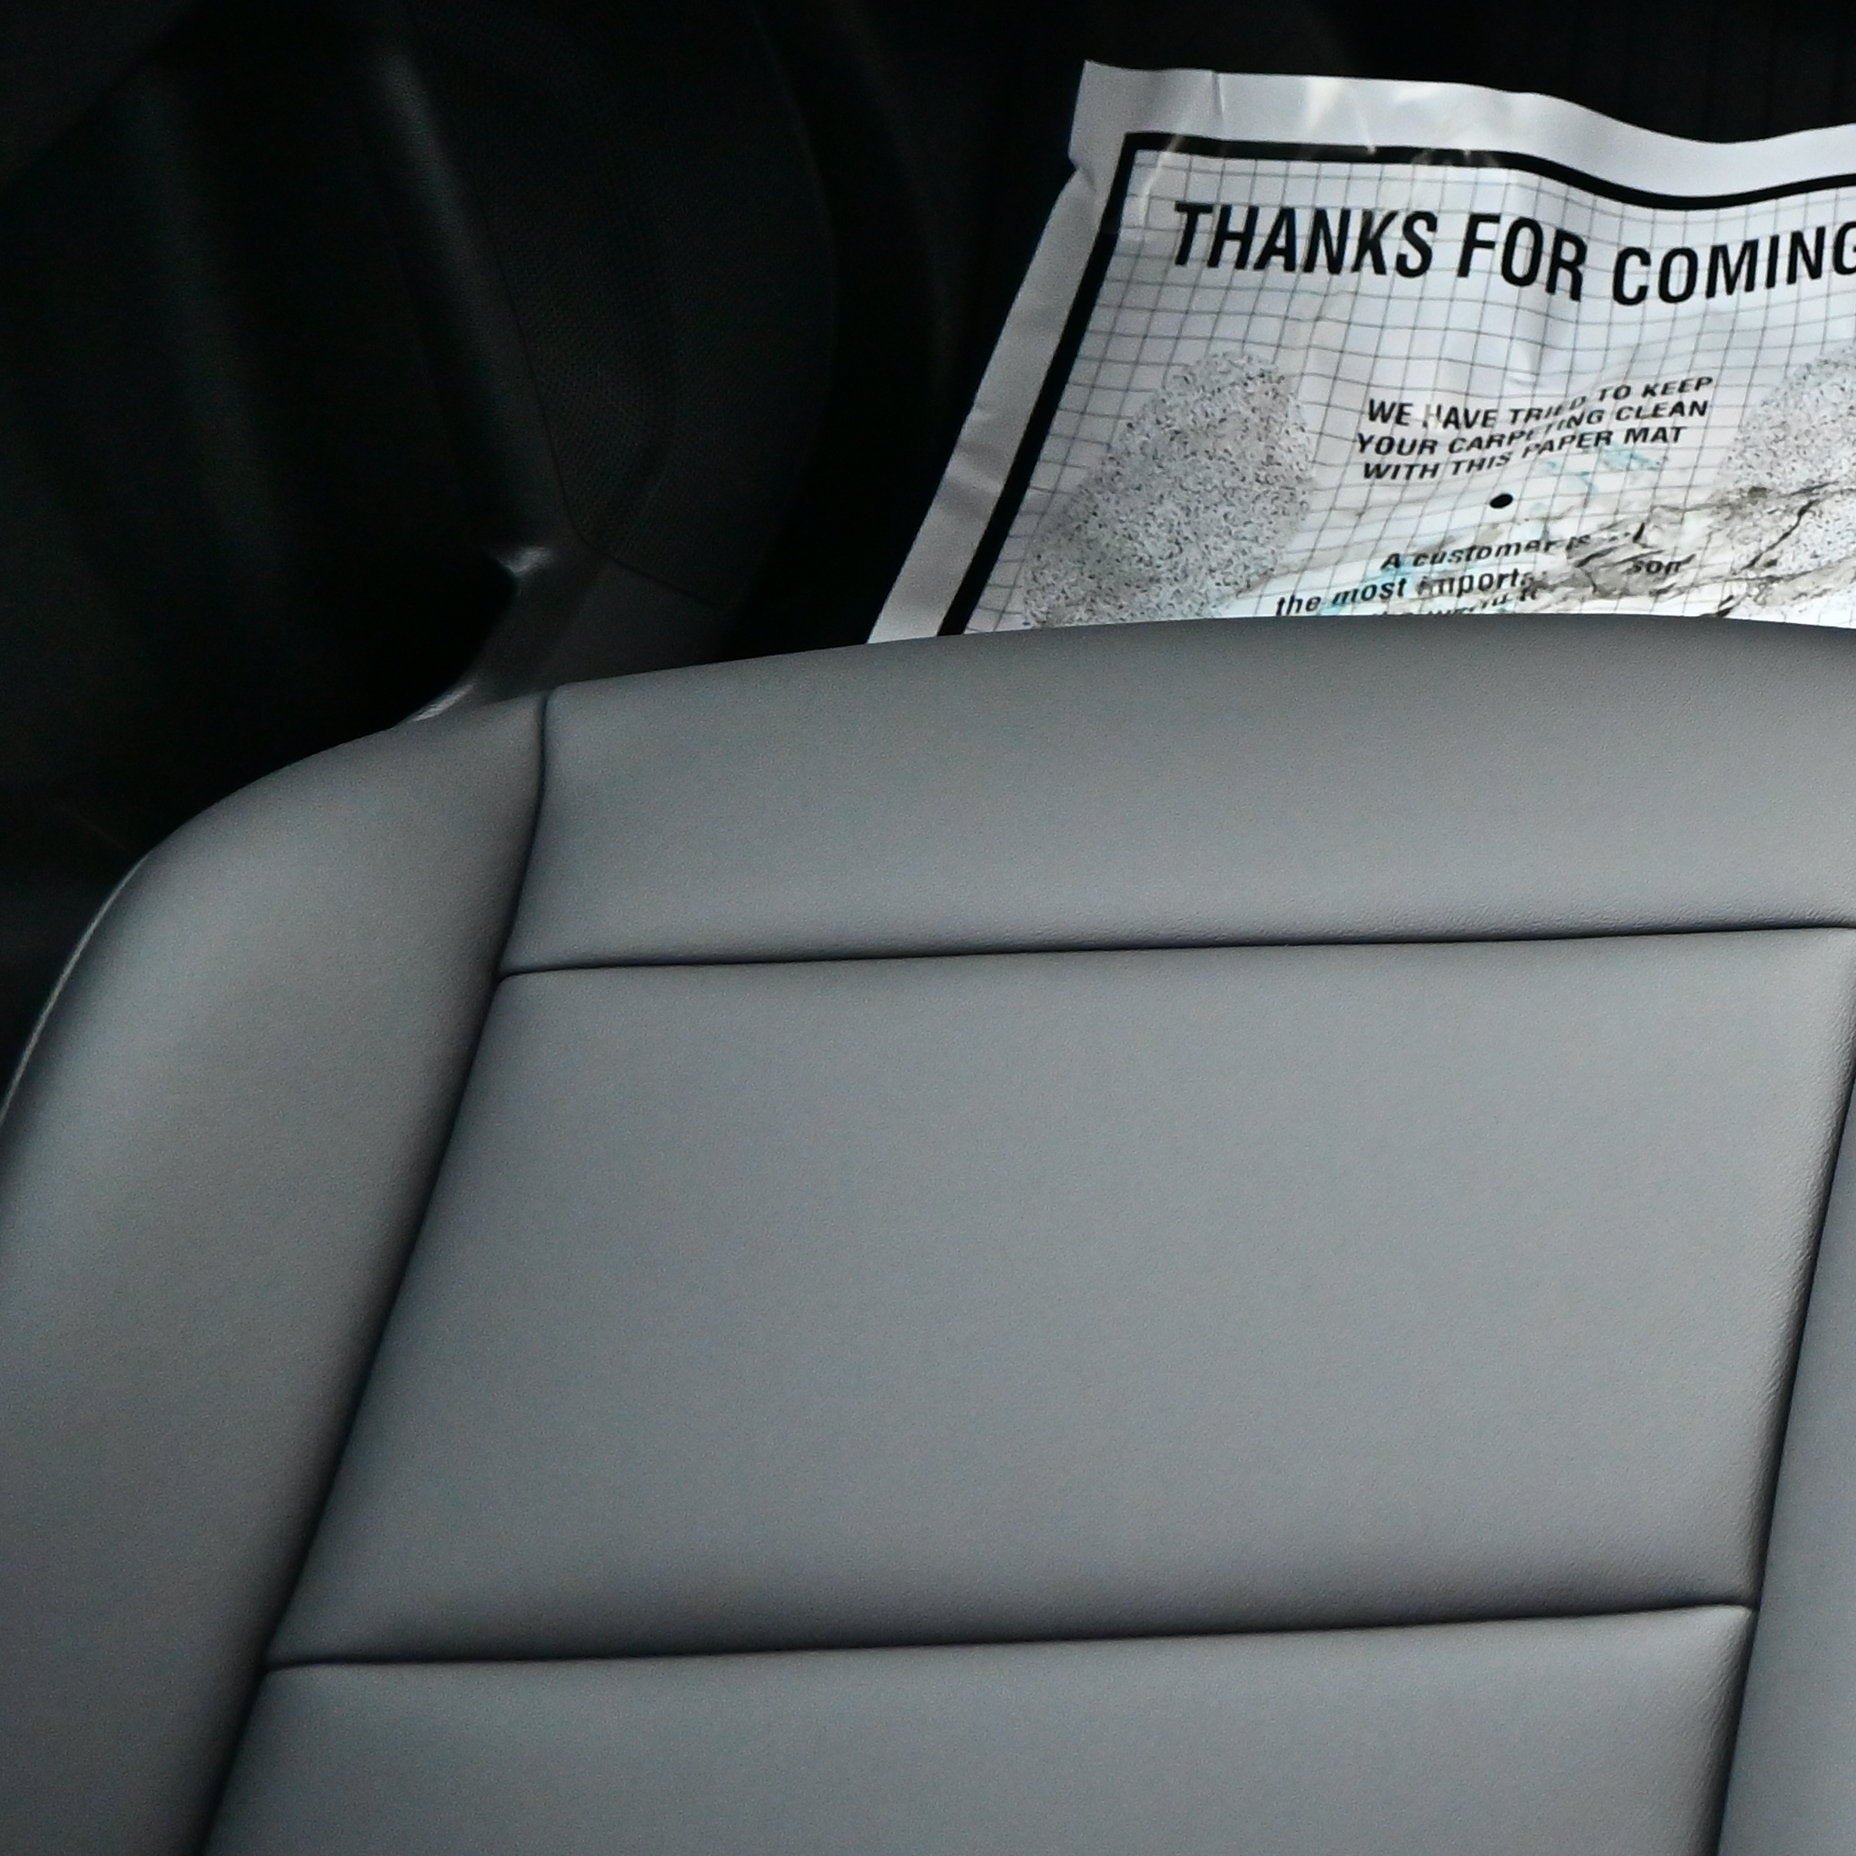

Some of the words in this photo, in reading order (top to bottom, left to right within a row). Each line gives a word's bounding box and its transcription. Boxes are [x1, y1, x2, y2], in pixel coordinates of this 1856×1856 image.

[1173, 202, 1437, 279] THANKS
[1457, 213, 1587, 305] FOR
[1357, 433, 1437, 456] YOUR
[1615, 400, 1709, 422] CLEAN
[1368, 399, 1413, 427] WE
[1422, 404, 1497, 430] HAVE
[1600, 384, 1631, 402] TO
[1641, 377, 1714, 399] KEEP
[1363, 462, 1440, 481] WITH
[1451, 452, 1512, 476] THIS
[1521, 430, 1613, 458] PAPER
[1624, 425, 1687, 445] MAT
[1380, 552, 1401, 570] A
[1413, 539, 1556, 567] customer
[1276, 595, 1322, 616] the
[1331, 574, 1407, 607] most
